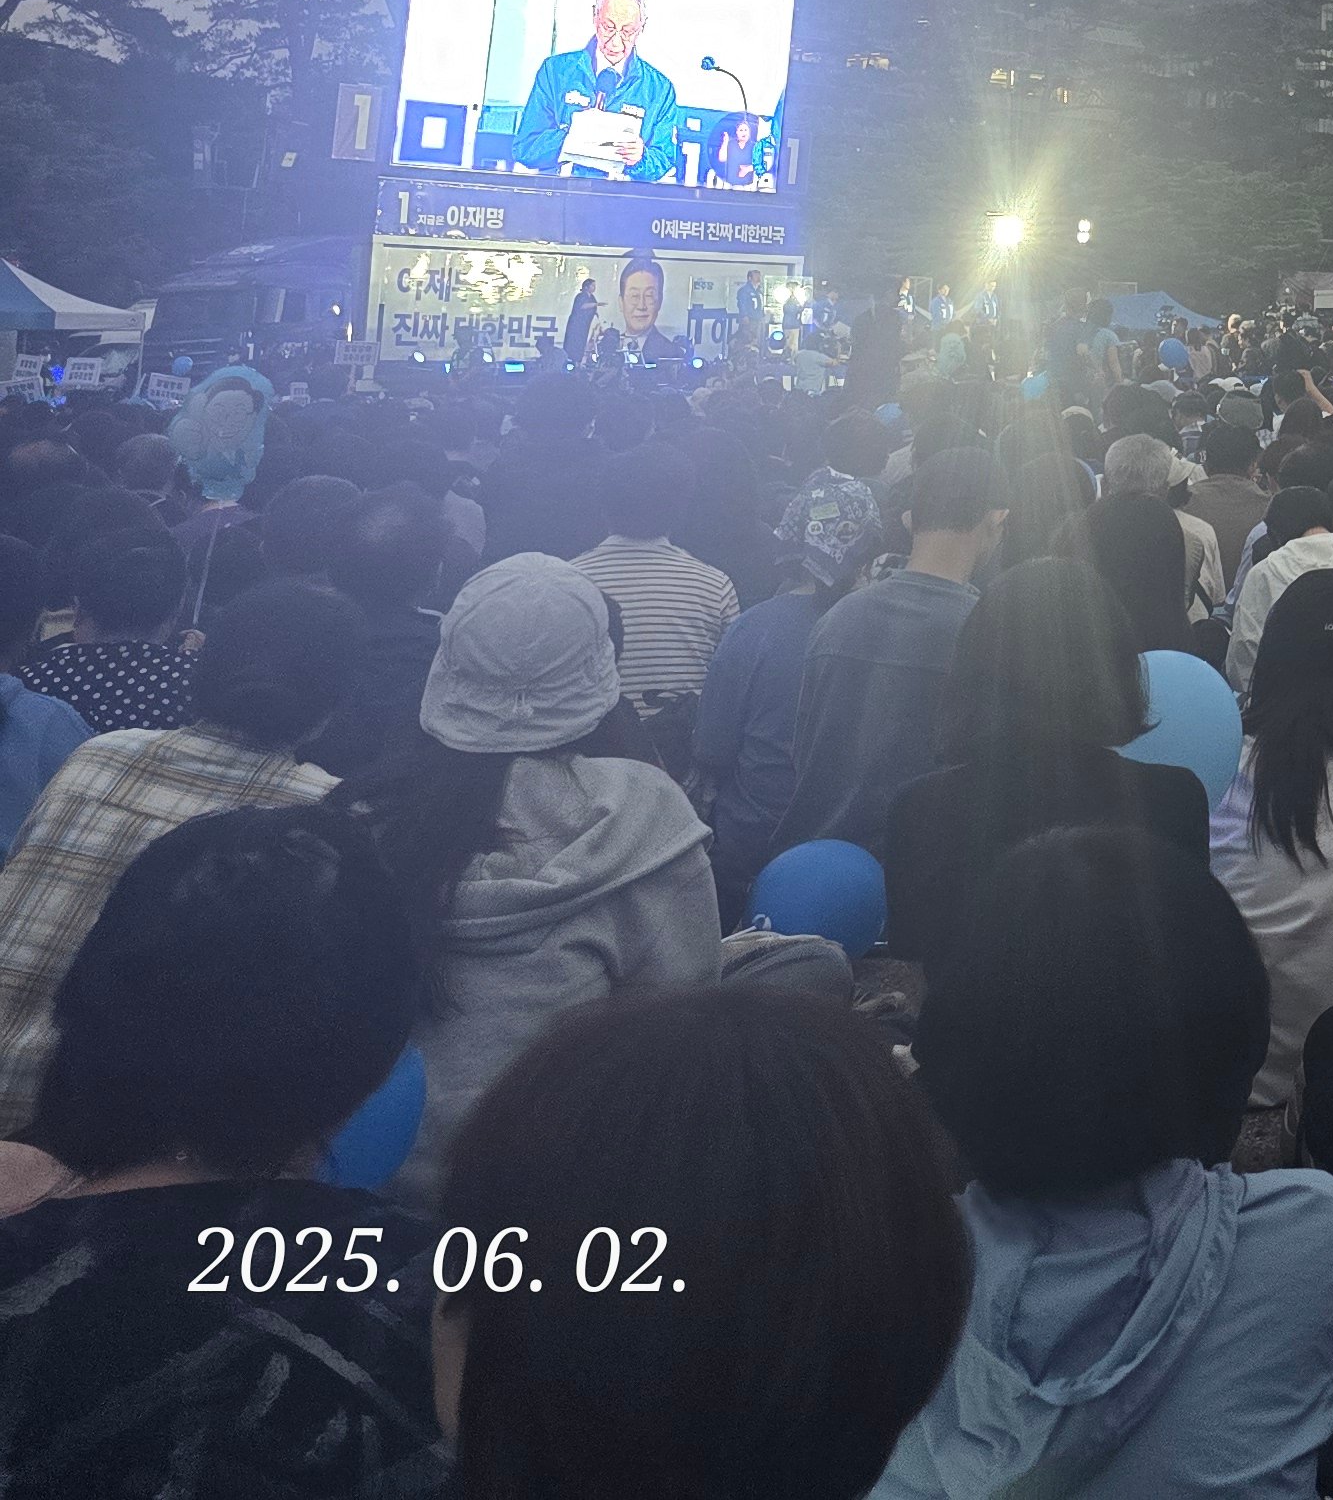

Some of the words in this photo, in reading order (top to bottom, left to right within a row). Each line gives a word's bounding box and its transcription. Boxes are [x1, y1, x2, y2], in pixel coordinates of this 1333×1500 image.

[354, 94, 371, 149] 1
[787, 138, 799, 185] 1
[398, 191, 410, 224] 1
[417, 214, 445, 226] 지금은
[652, 219, 705, 241] 이제부터
[707, 222, 733, 242] 진짜
[734, 224, 786, 245] 대한민국
[392, 311, 449, 348] 진짜
